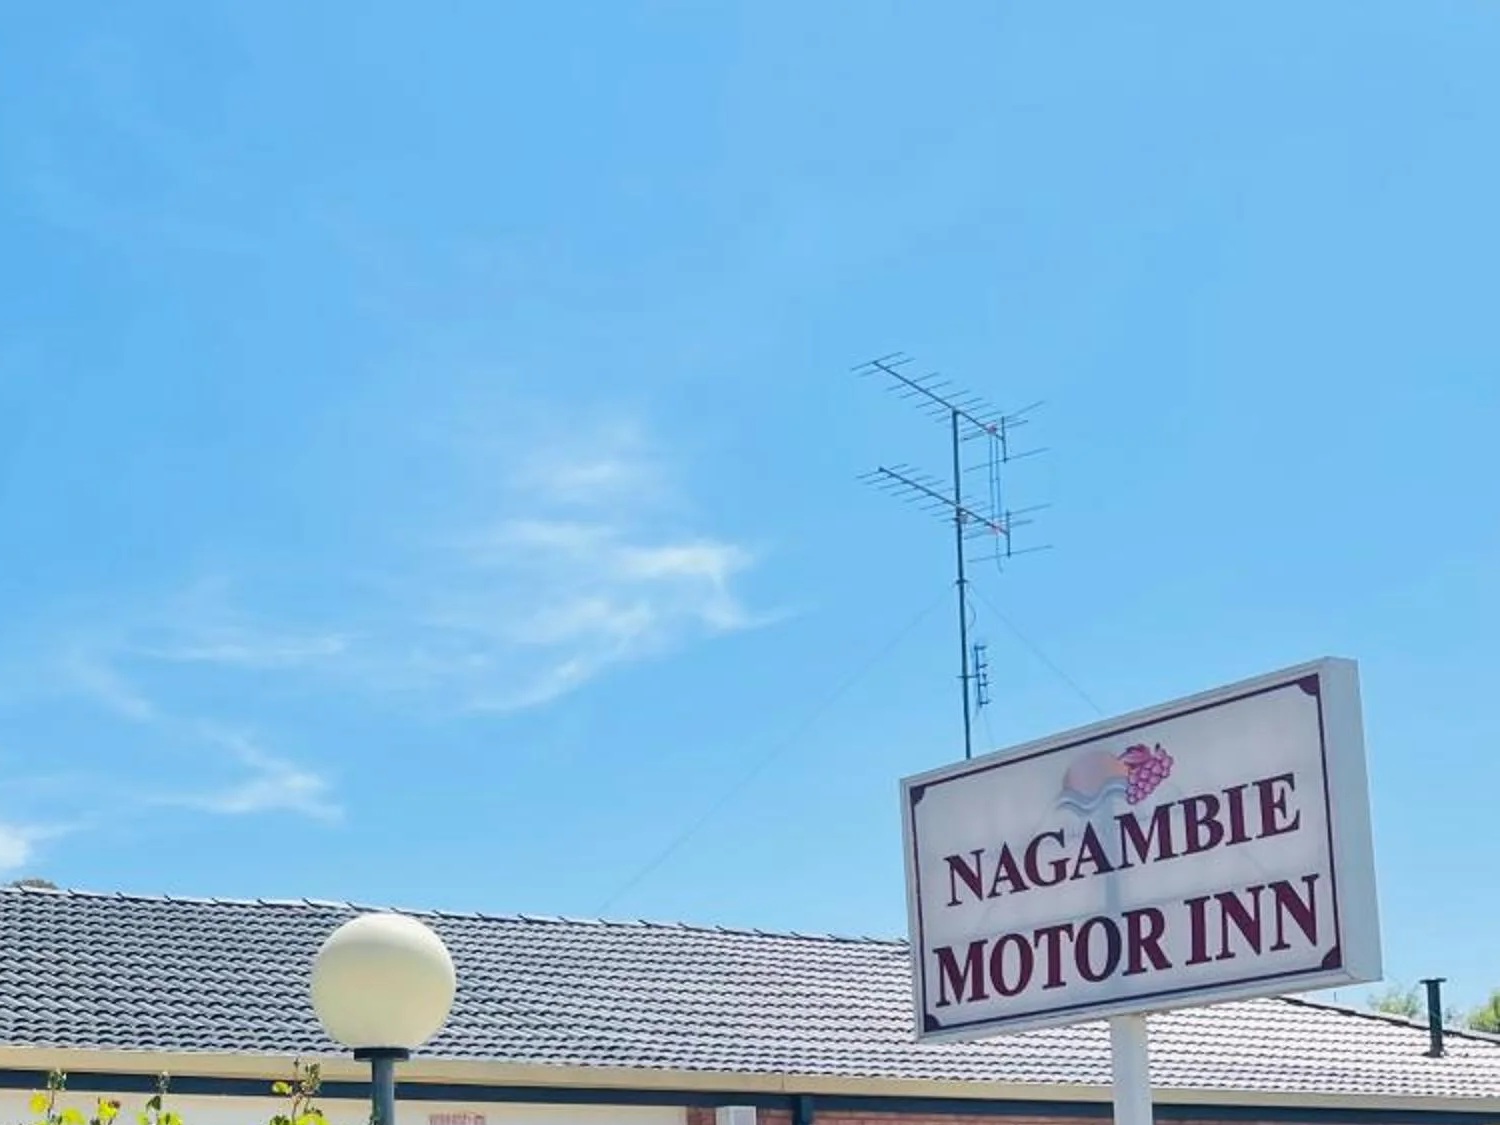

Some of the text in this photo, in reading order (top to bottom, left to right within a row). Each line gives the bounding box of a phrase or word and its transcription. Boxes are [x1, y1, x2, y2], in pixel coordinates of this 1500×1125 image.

[943, 772, 1301, 907] NAGAMBIE
[932, 873, 1321, 1008] MOTOR INN
